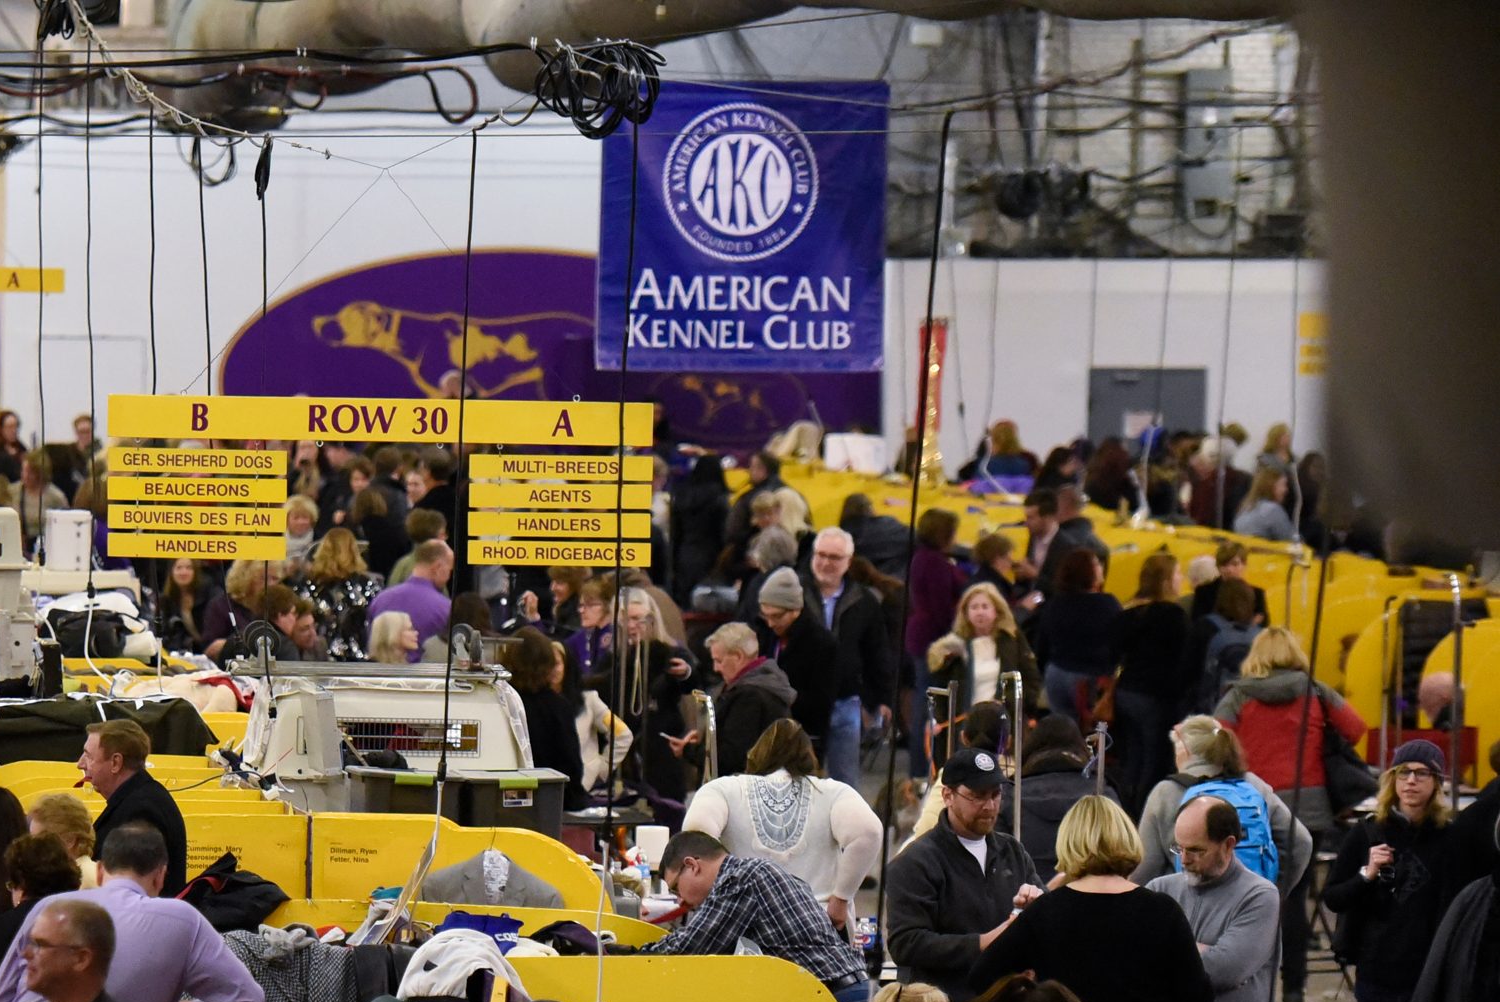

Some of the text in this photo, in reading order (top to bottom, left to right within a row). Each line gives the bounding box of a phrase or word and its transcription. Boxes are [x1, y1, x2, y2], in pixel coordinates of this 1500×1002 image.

[671, 111, 810, 195] AMERICAN KENNEL CLUB
[696, 135, 788, 233] AKC
[691, 224, 754, 252] FOUNDED
[7, 271, 20, 289] A
[629, 267, 852, 312] AMERICAN
[627, 313, 852, 350] KENNEL CLUB
[191, 403, 575, 437] B ROW 30 A
[122, 453, 273, 469] GER. SHEPHERD DOGS
[502, 460, 619, 475] MULTI-BREEDS
[144, 482, 250, 497] BEAUCERONS
[528, 489, 592, 503] AGENTS
[123, 510, 271, 527] BOUVIERS DES FLAN
[517, 518, 601, 532] HANDLERS
[155, 539, 237, 554] HANDLERS
[482, 546, 636, 561] RHOD. RIDGEBACKS
[329, 847, 378, 856] Dillman, Ryan
